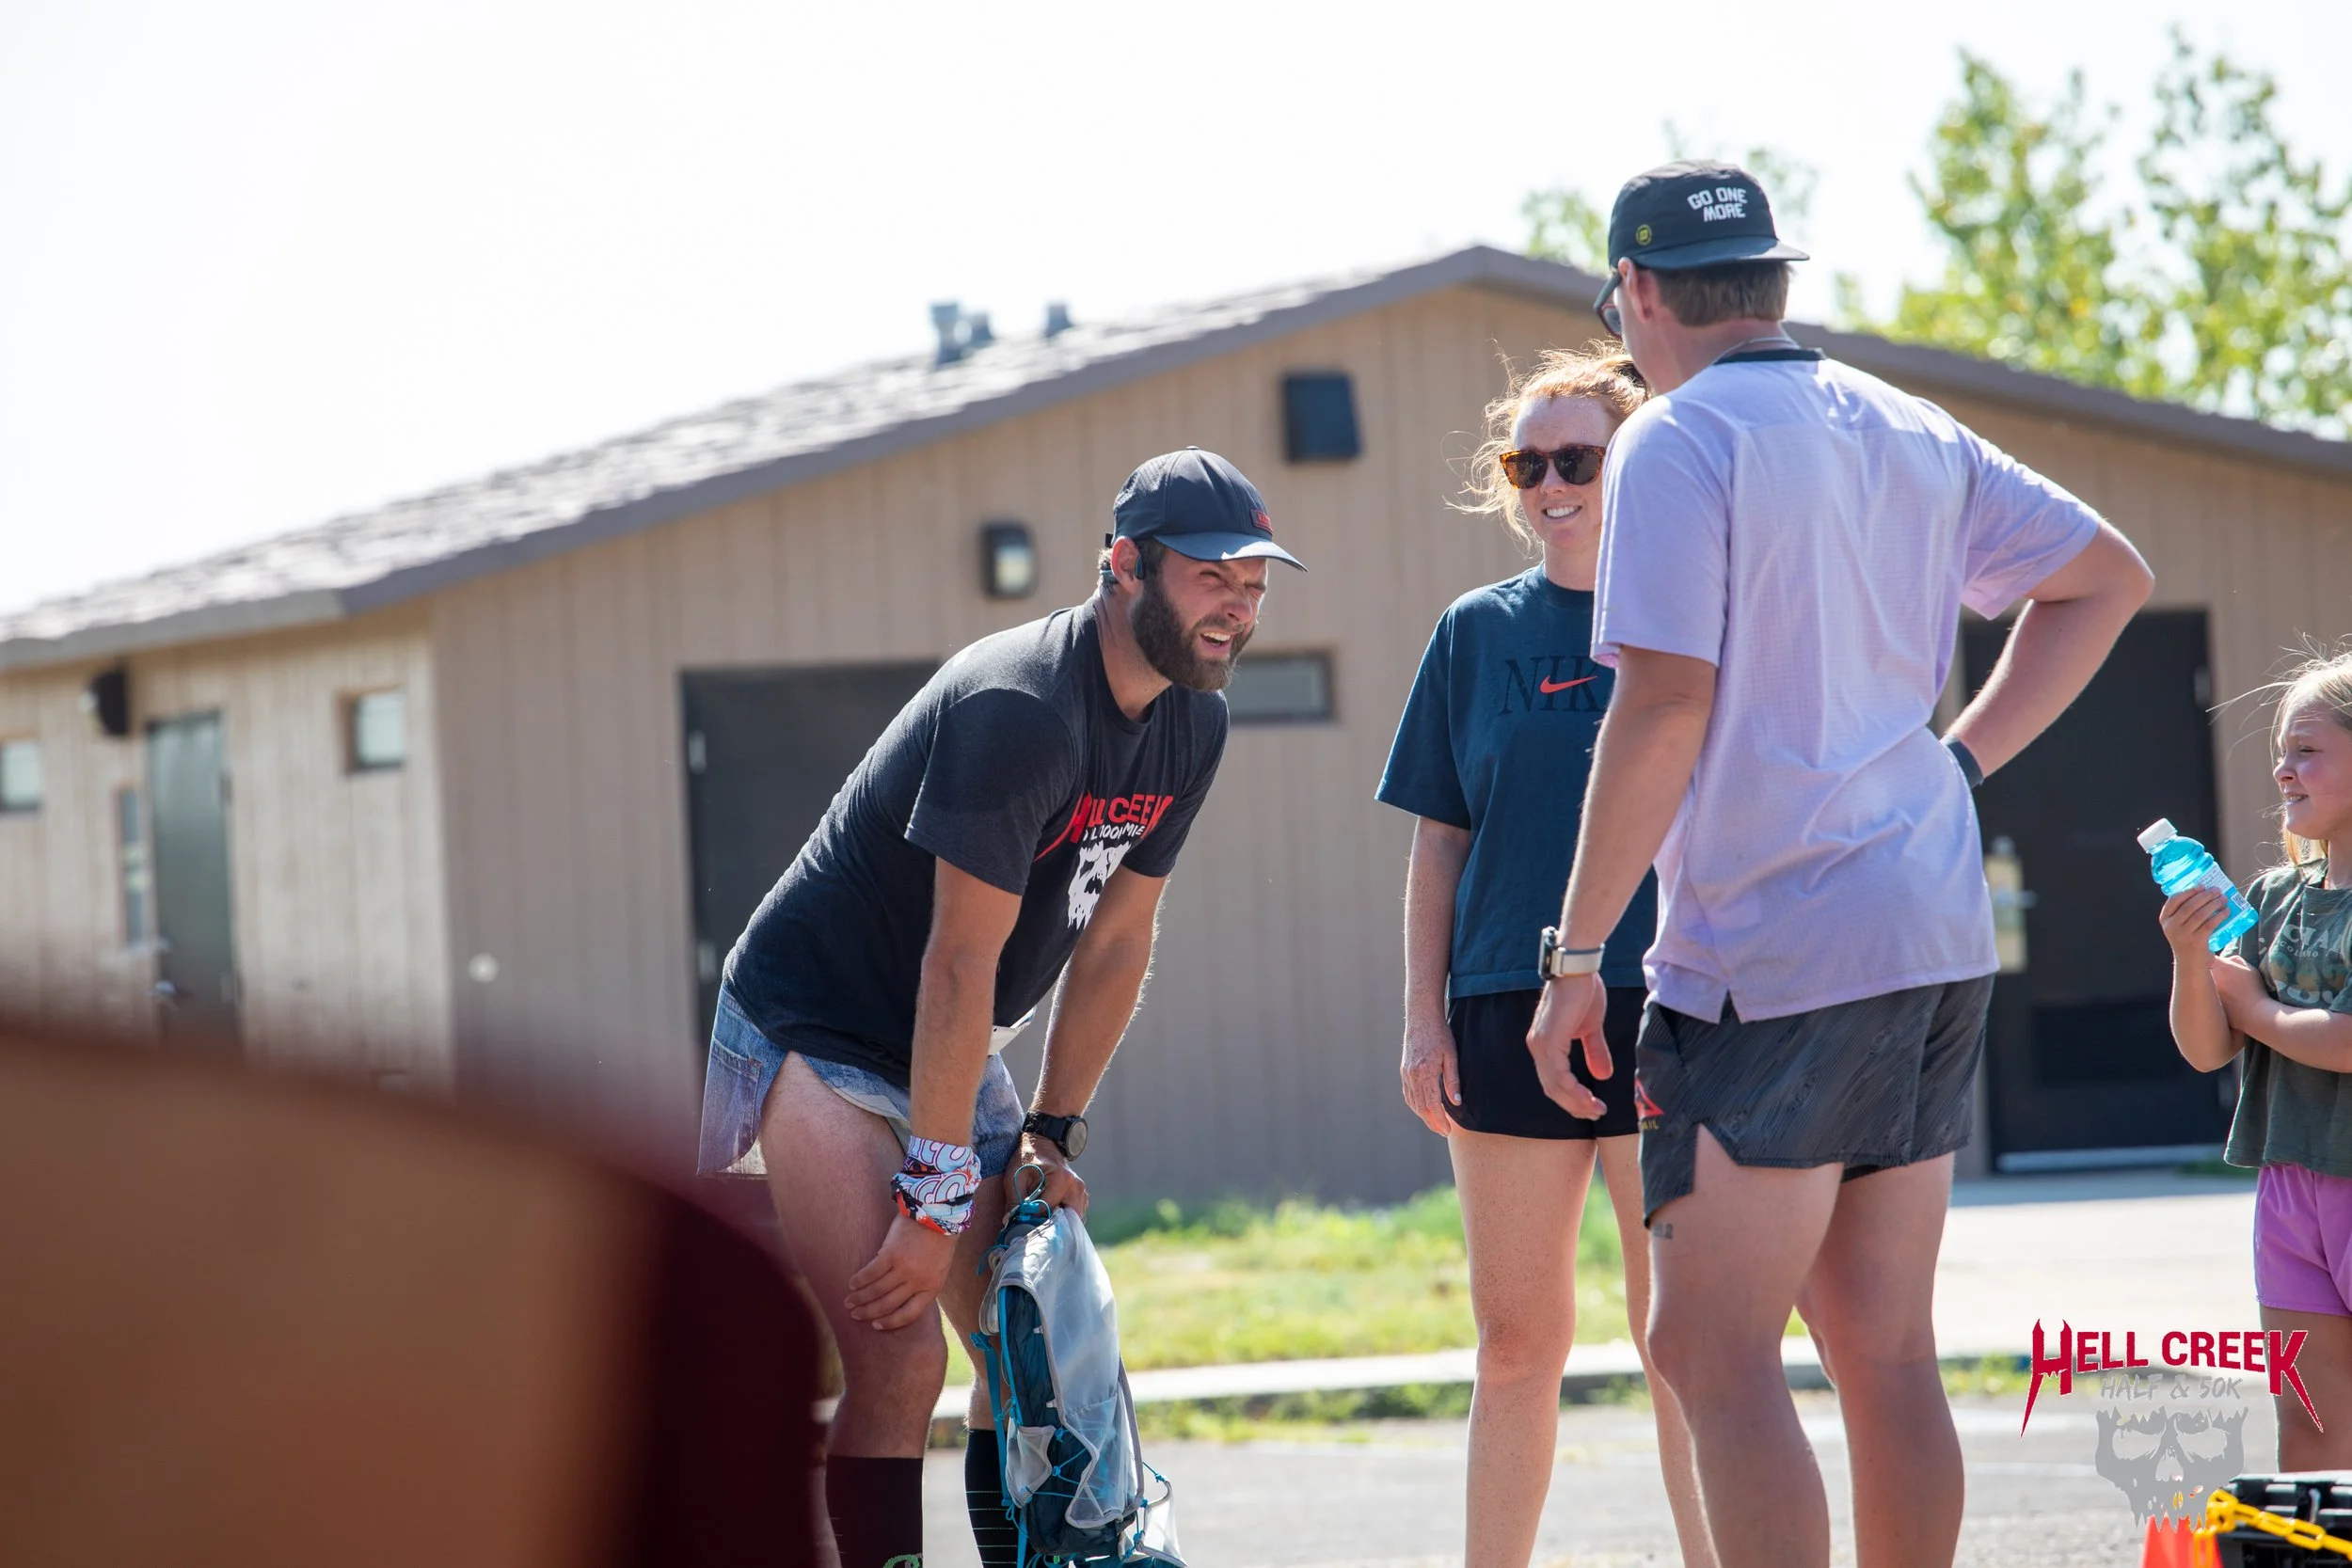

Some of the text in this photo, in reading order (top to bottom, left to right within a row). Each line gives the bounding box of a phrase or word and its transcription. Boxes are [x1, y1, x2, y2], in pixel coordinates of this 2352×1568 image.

[1687, 187, 1747, 210] GO ONE
[1703, 203, 1747, 222] MORE
[1498, 656, 1605, 717] NIK
[1107, 793, 1174, 839] CEEK
